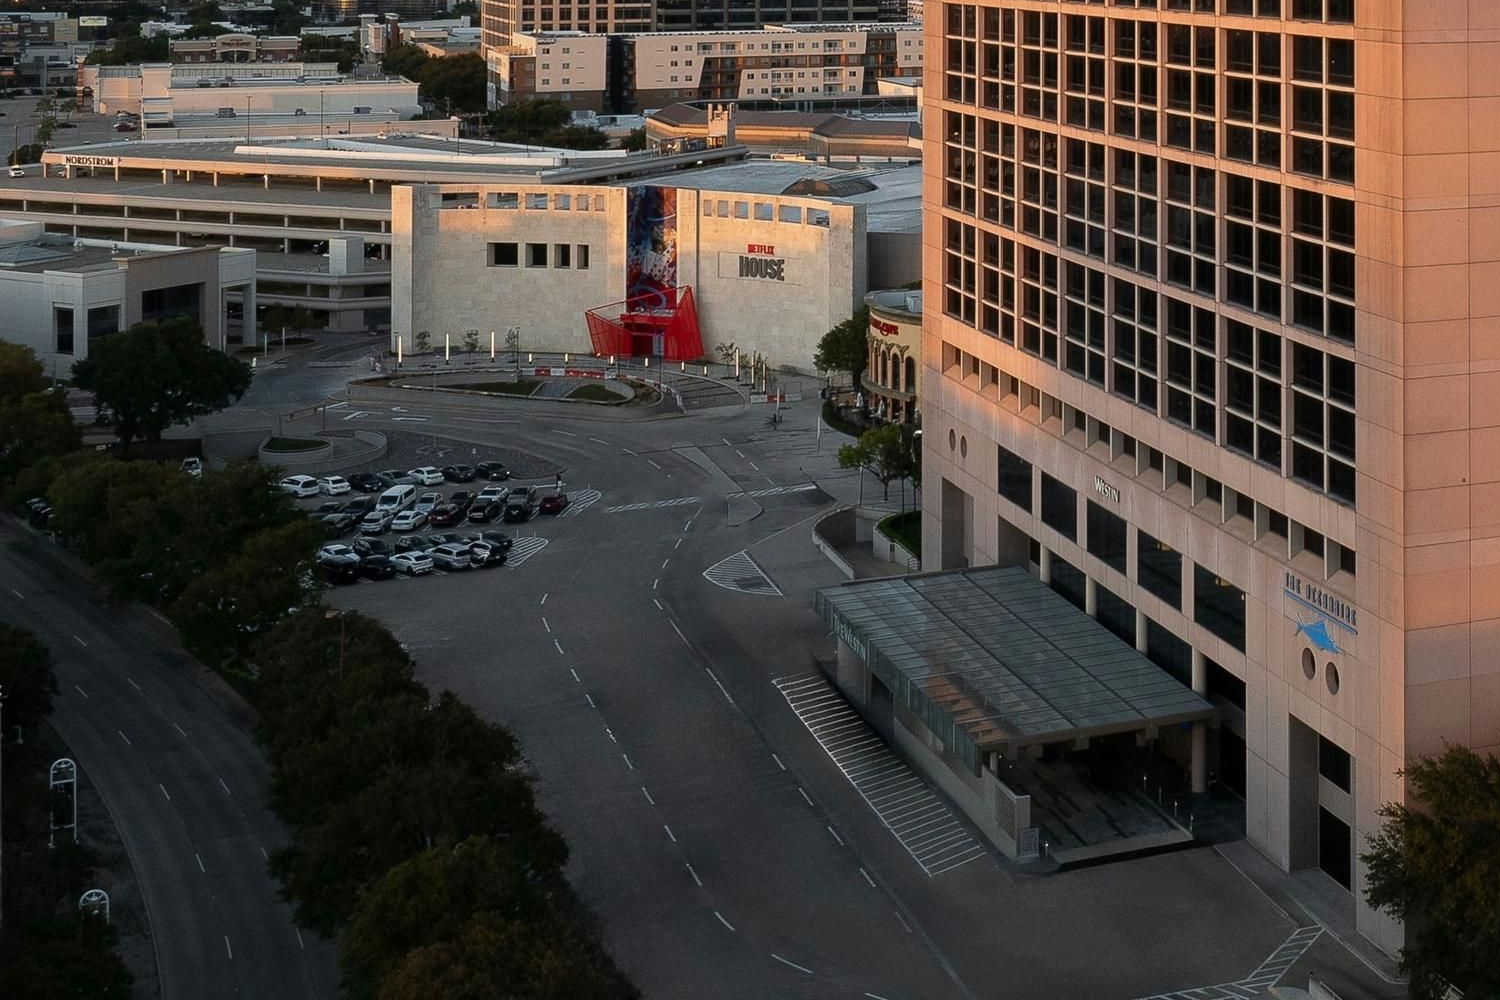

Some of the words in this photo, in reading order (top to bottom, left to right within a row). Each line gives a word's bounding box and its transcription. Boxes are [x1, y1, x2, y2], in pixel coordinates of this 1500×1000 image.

[65, 156, 114, 166] NORDSTROM
[747, 243, 775, 256] NETFLIX
[738, 255, 785, 281] HOUSE
[1093, 474, 1120, 503] WESTIN
